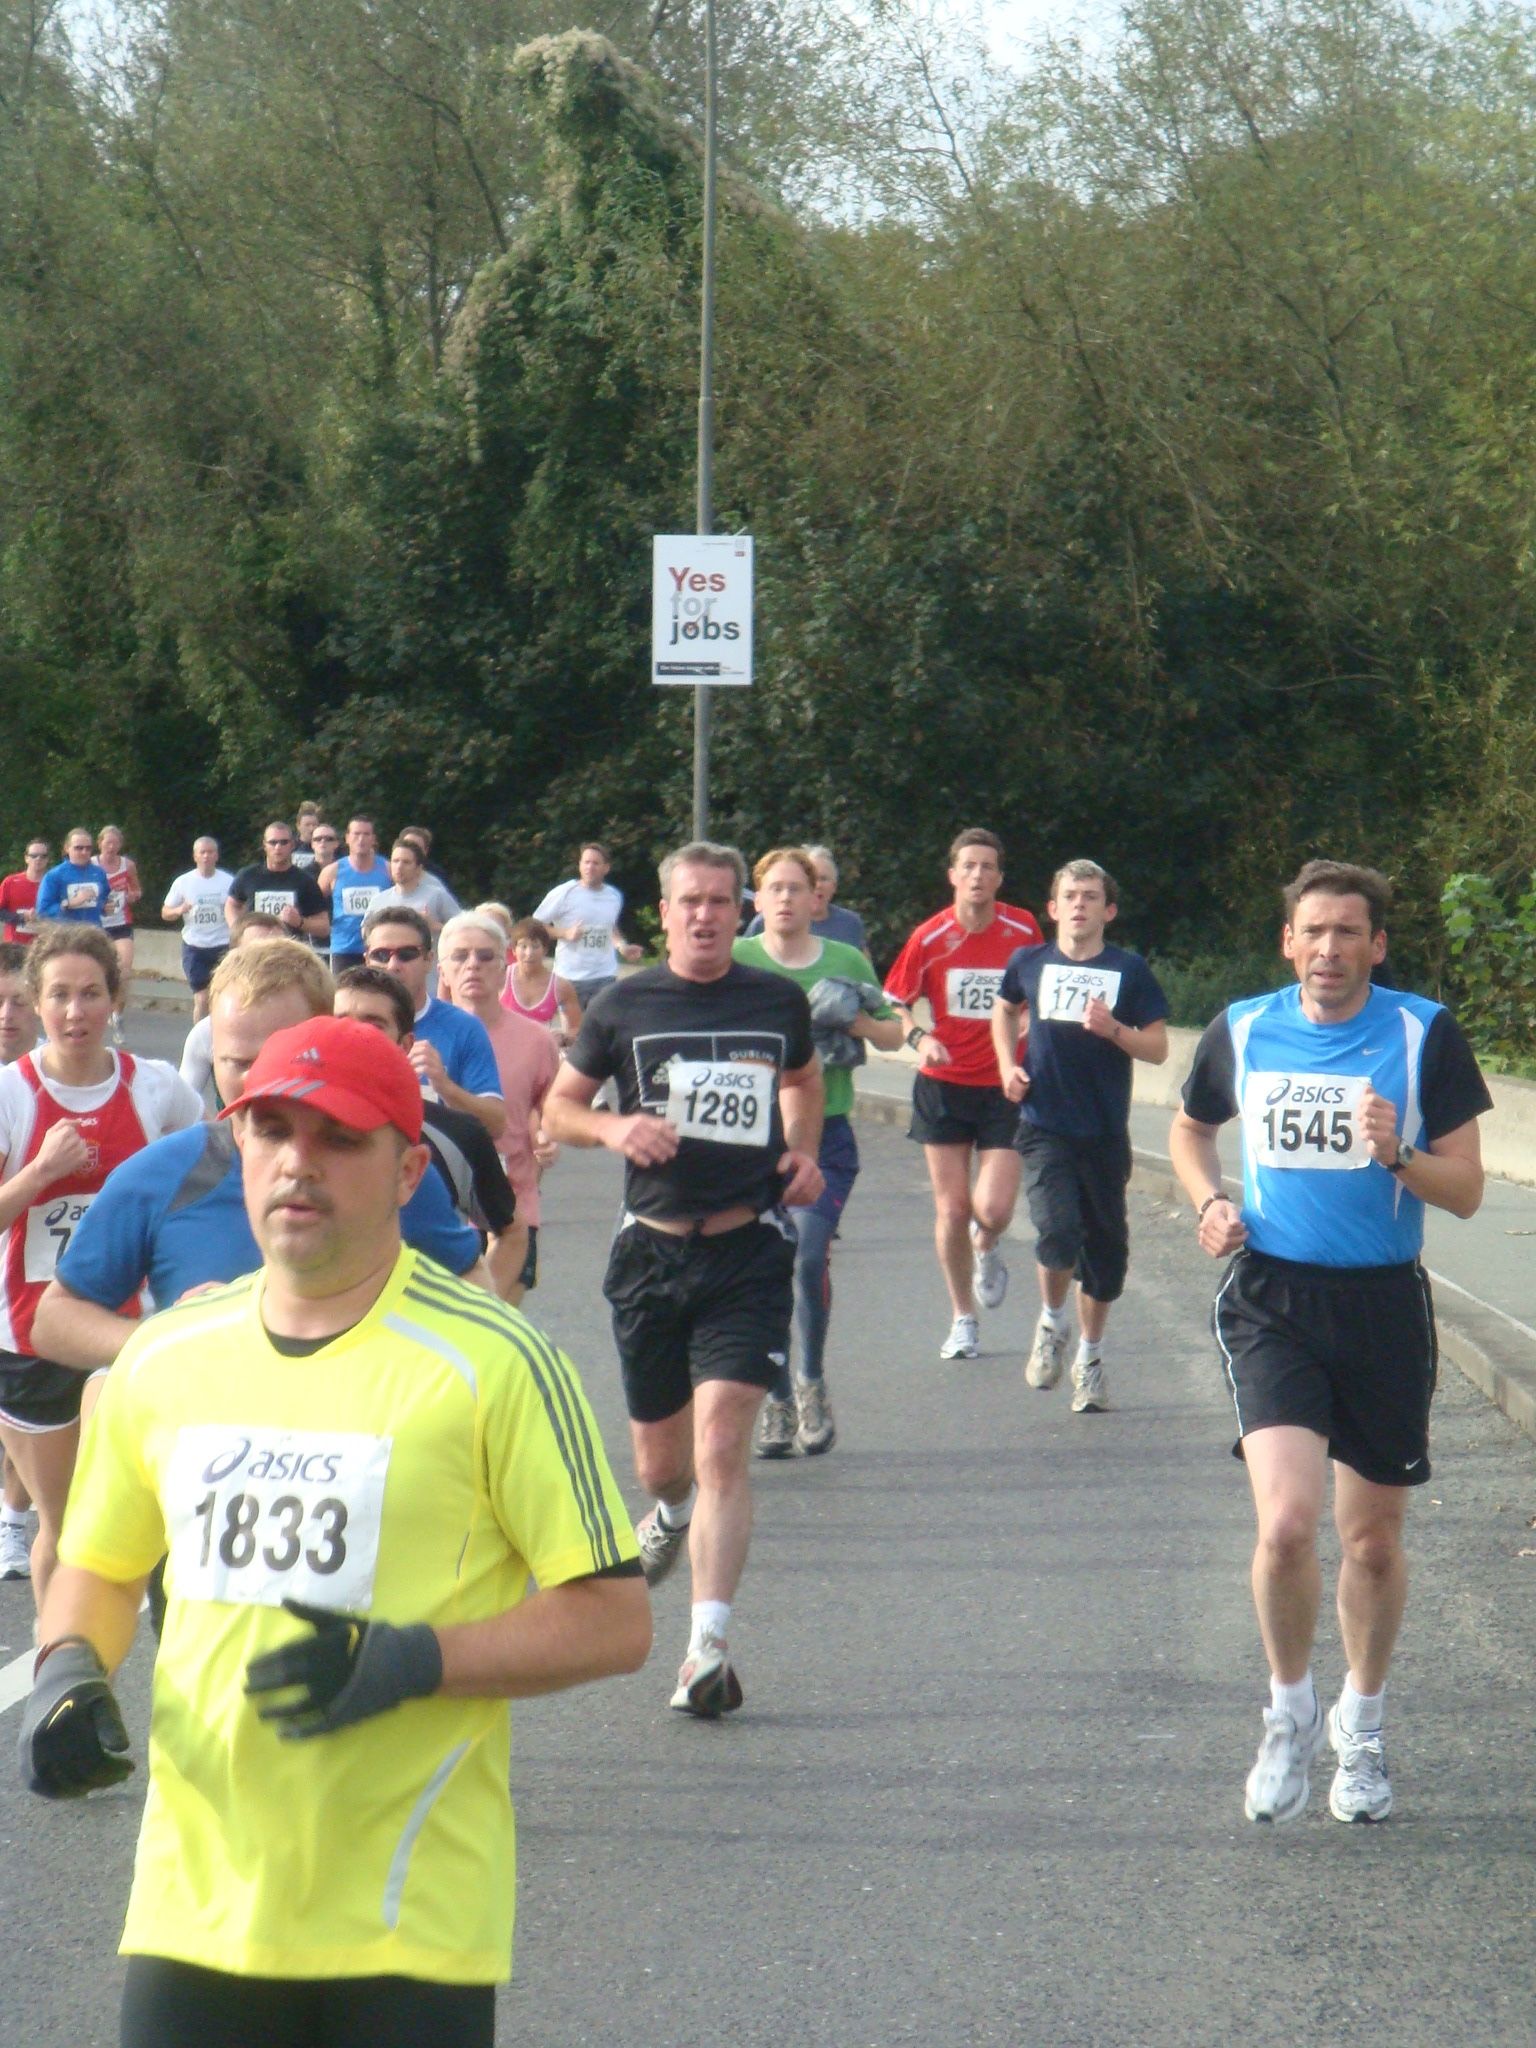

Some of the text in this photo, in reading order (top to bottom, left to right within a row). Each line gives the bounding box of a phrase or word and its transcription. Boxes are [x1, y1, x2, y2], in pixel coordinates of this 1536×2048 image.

[668, 566, 726, 592] Yes
[670, 590, 717, 616] for
[668, 614, 740, 645] jobs
[350, 896, 372, 910] 160
[194, 912, 217, 924] 1230
[1072, 974, 1104, 986] asics
[957, 988, 1001, 1010] 125
[714, 1071, 756, 1088] asics
[1291, 1086, 1345, 1104] asics
[685, 1089, 758, 1129] 1289
[1263, 1108, 1353, 1153] 1545
[248, 1450, 343, 1482] asics
[195, 1490, 348, 1575] 1833
